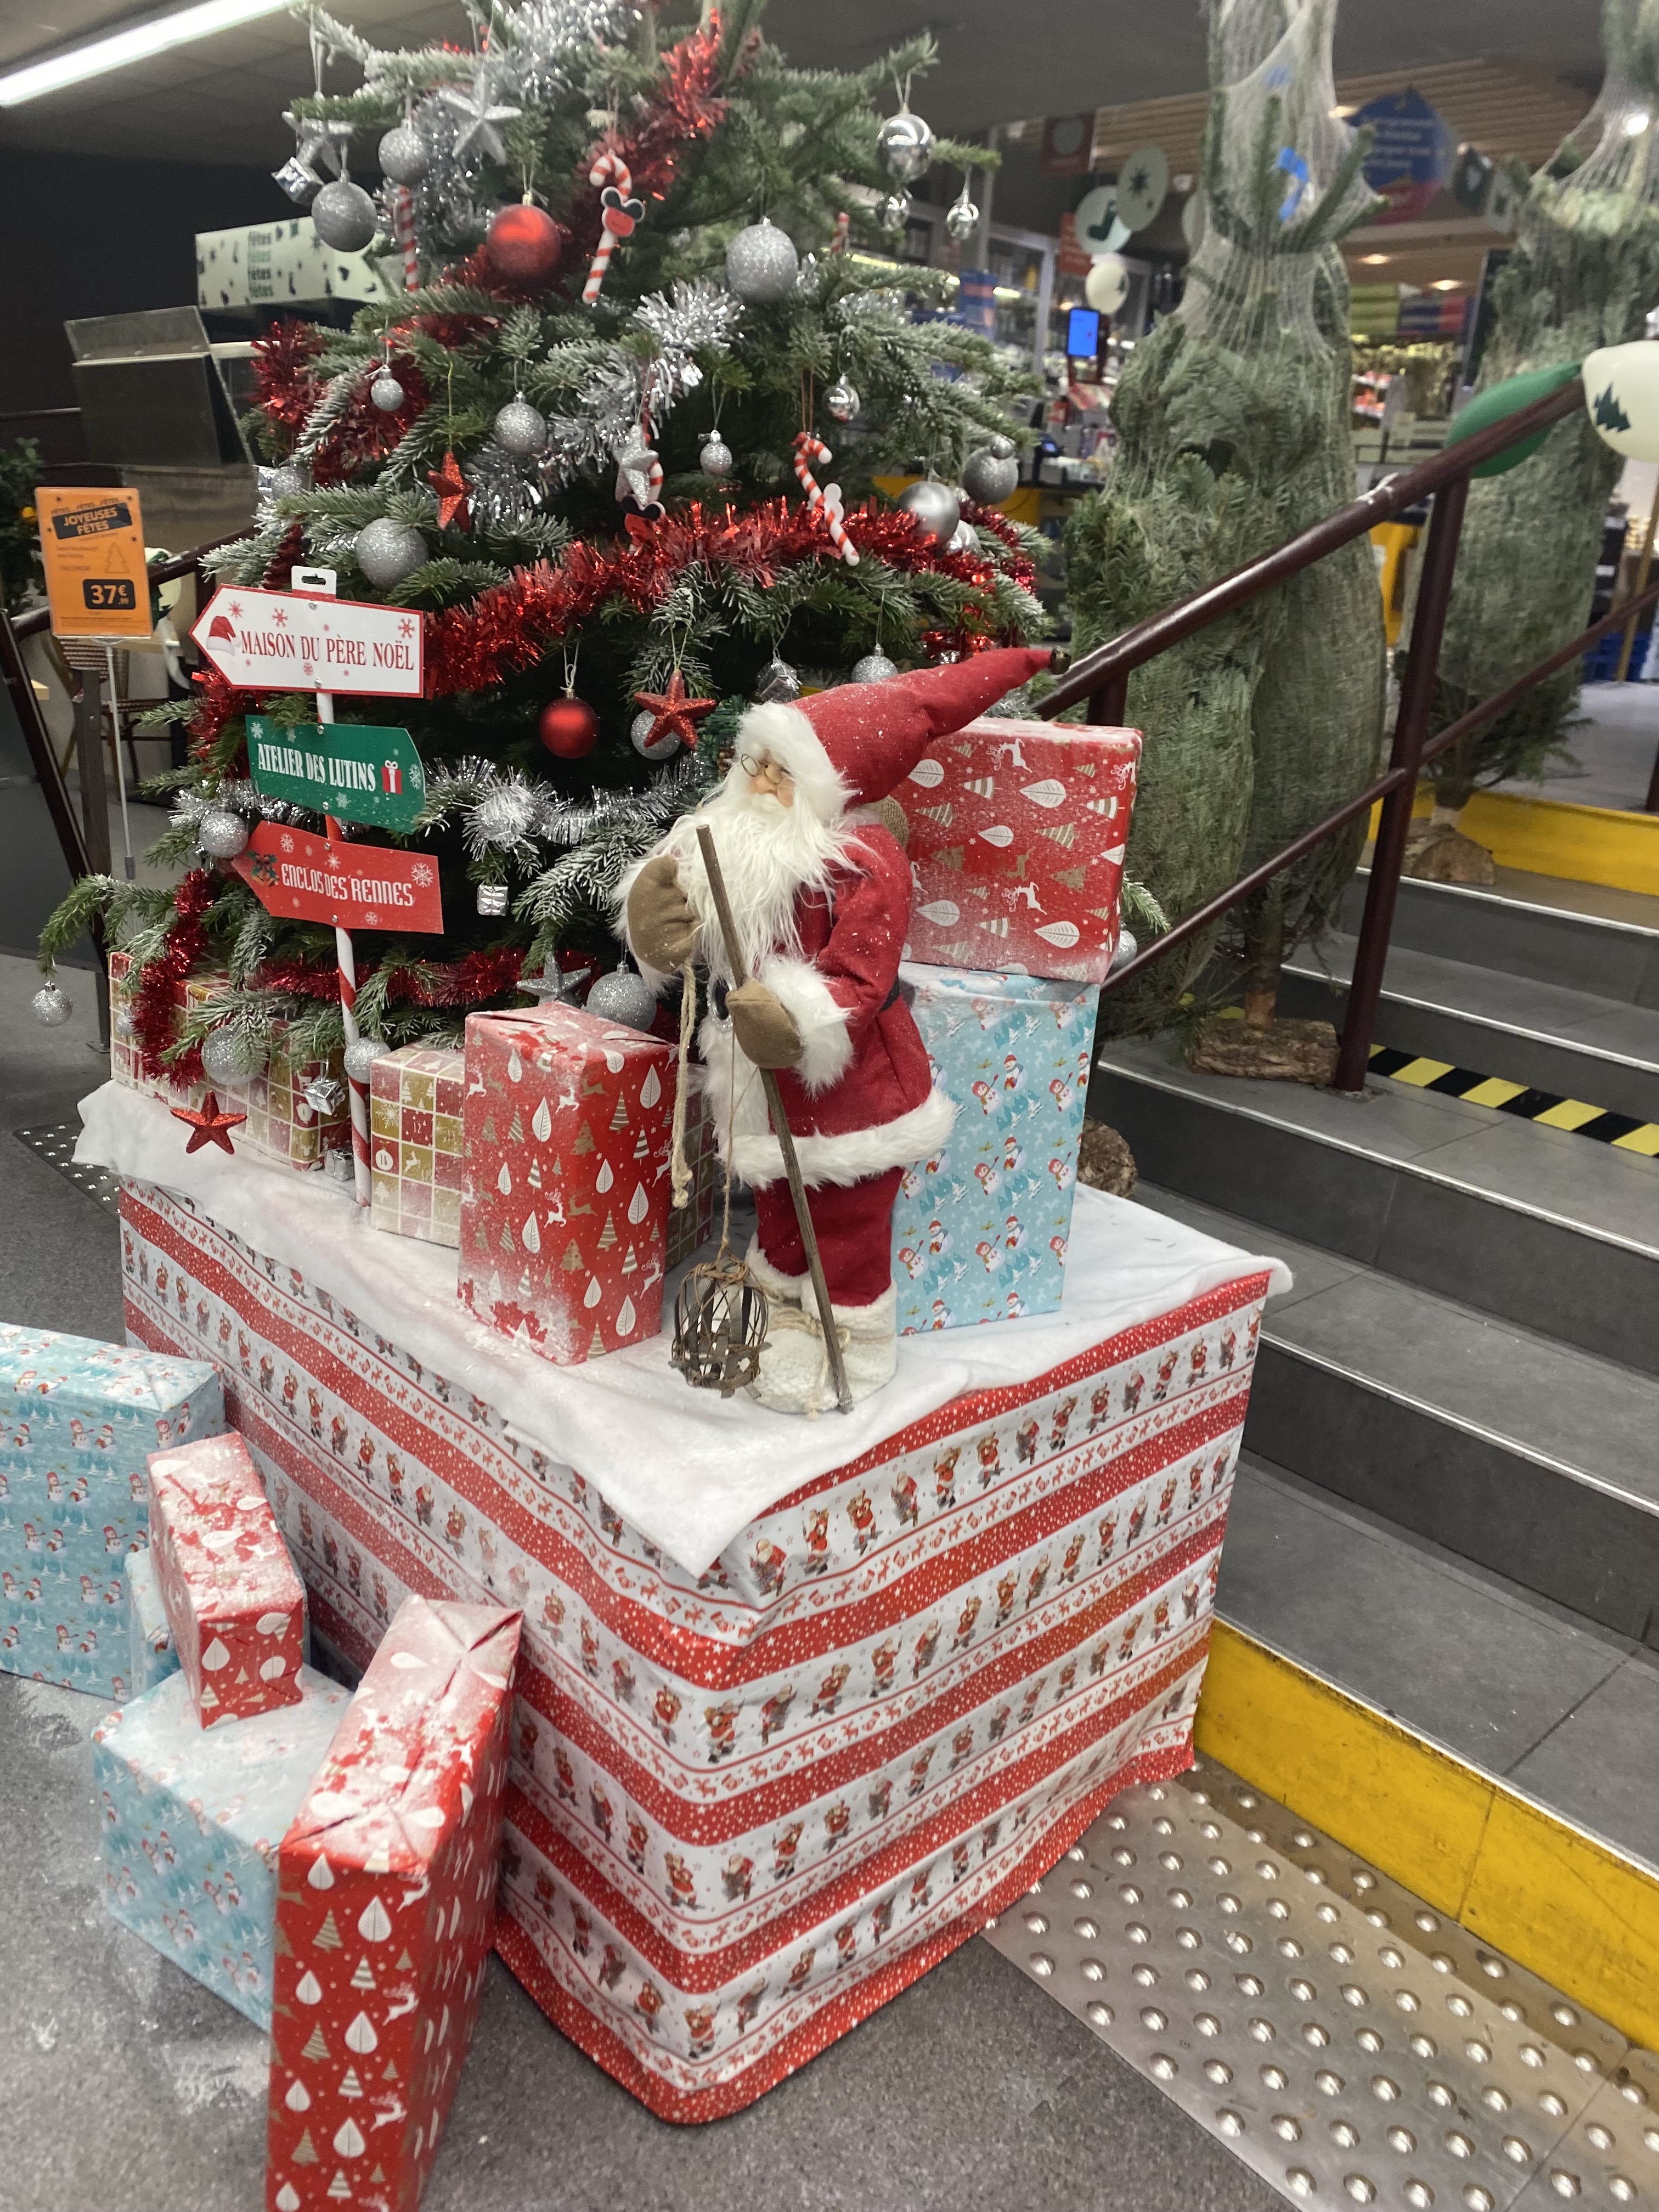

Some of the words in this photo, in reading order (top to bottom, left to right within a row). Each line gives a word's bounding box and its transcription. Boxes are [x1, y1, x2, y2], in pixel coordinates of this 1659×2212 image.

[64, 507, 117, 526] JOYEUSES
[241, 630, 296, 658] MAISON
[300, 636, 320, 662] DU
[326, 634, 366, 665] PÈRE
[373, 640, 414, 670] NOËL
[257, 743, 304, 778] ATELIER
[304, 752, 326, 783] DES
[328, 757, 376, 792] LUTINS
[324, 873, 348, 900] DES
[413, 1121, 422, 1134] 12
[380, 1153, 387, 1166] 16
